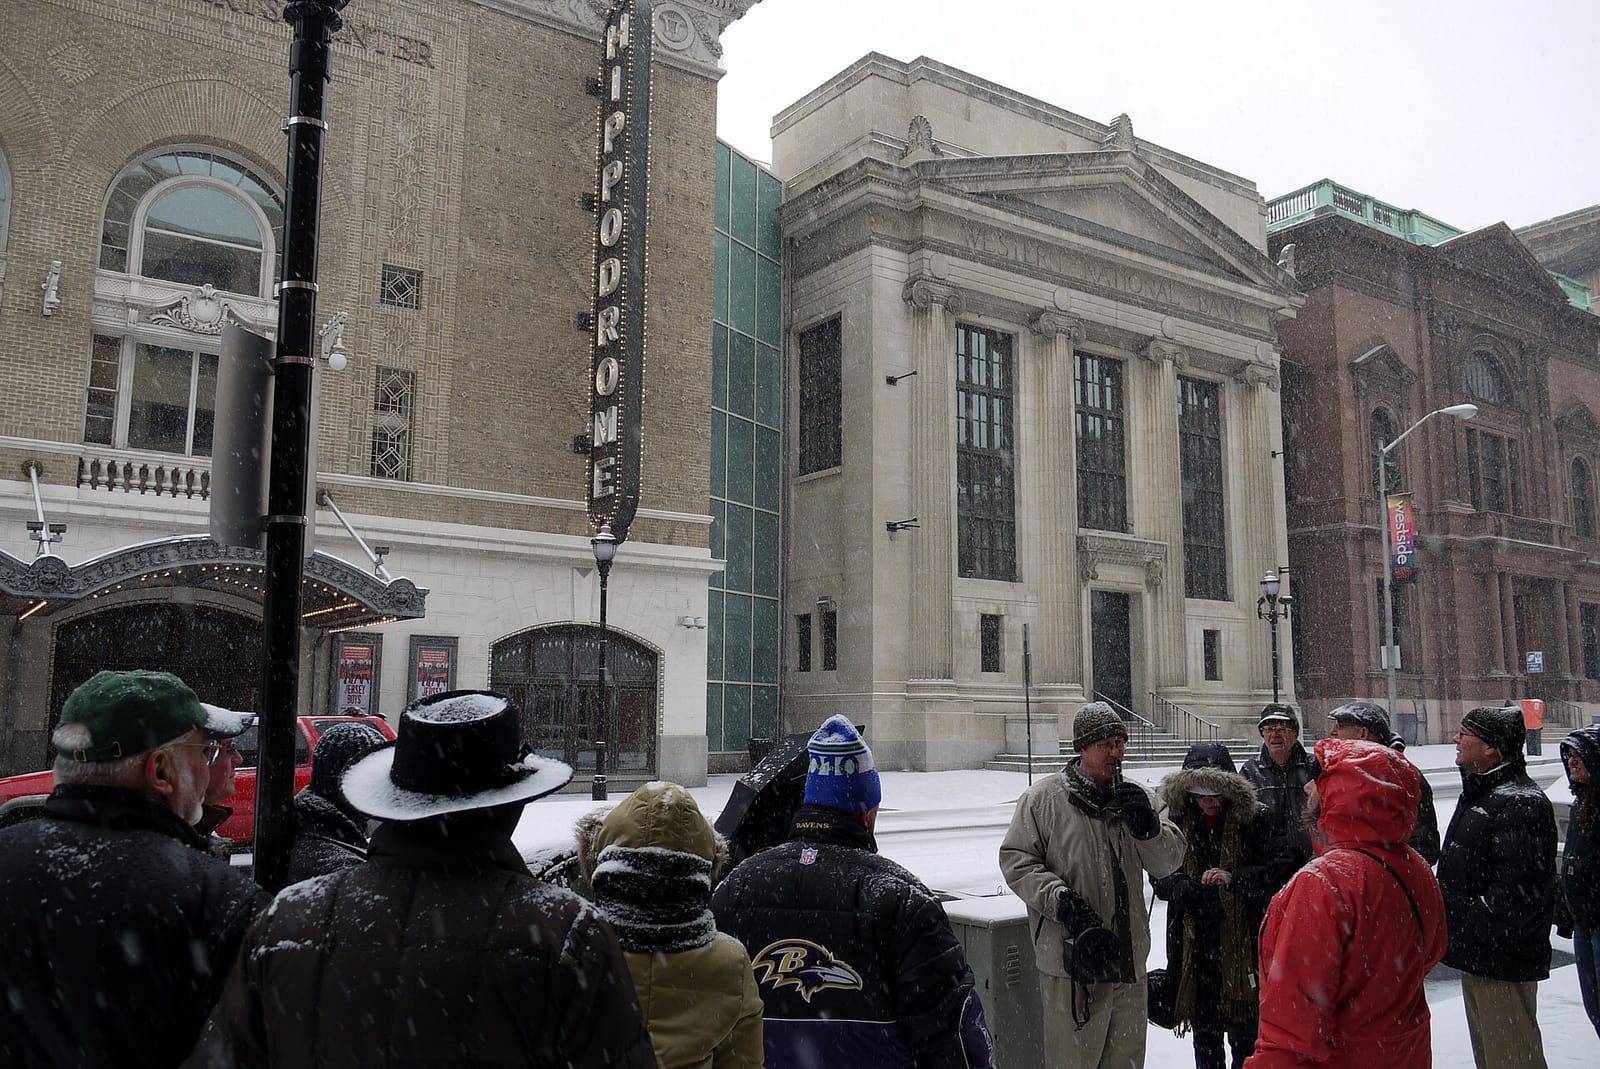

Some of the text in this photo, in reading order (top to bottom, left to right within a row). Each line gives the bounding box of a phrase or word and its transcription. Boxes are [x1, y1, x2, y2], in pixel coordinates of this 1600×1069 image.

[593, 13, 630, 500] HIPPODROME
[1084, 262, 1180, 305] NATIONAL
[1198, 294, 1243, 321] BANK
[1394, 500, 1413, 564] westside
[345, 684, 366, 696] JERSEY
[346, 695, 363, 705] BOYS
